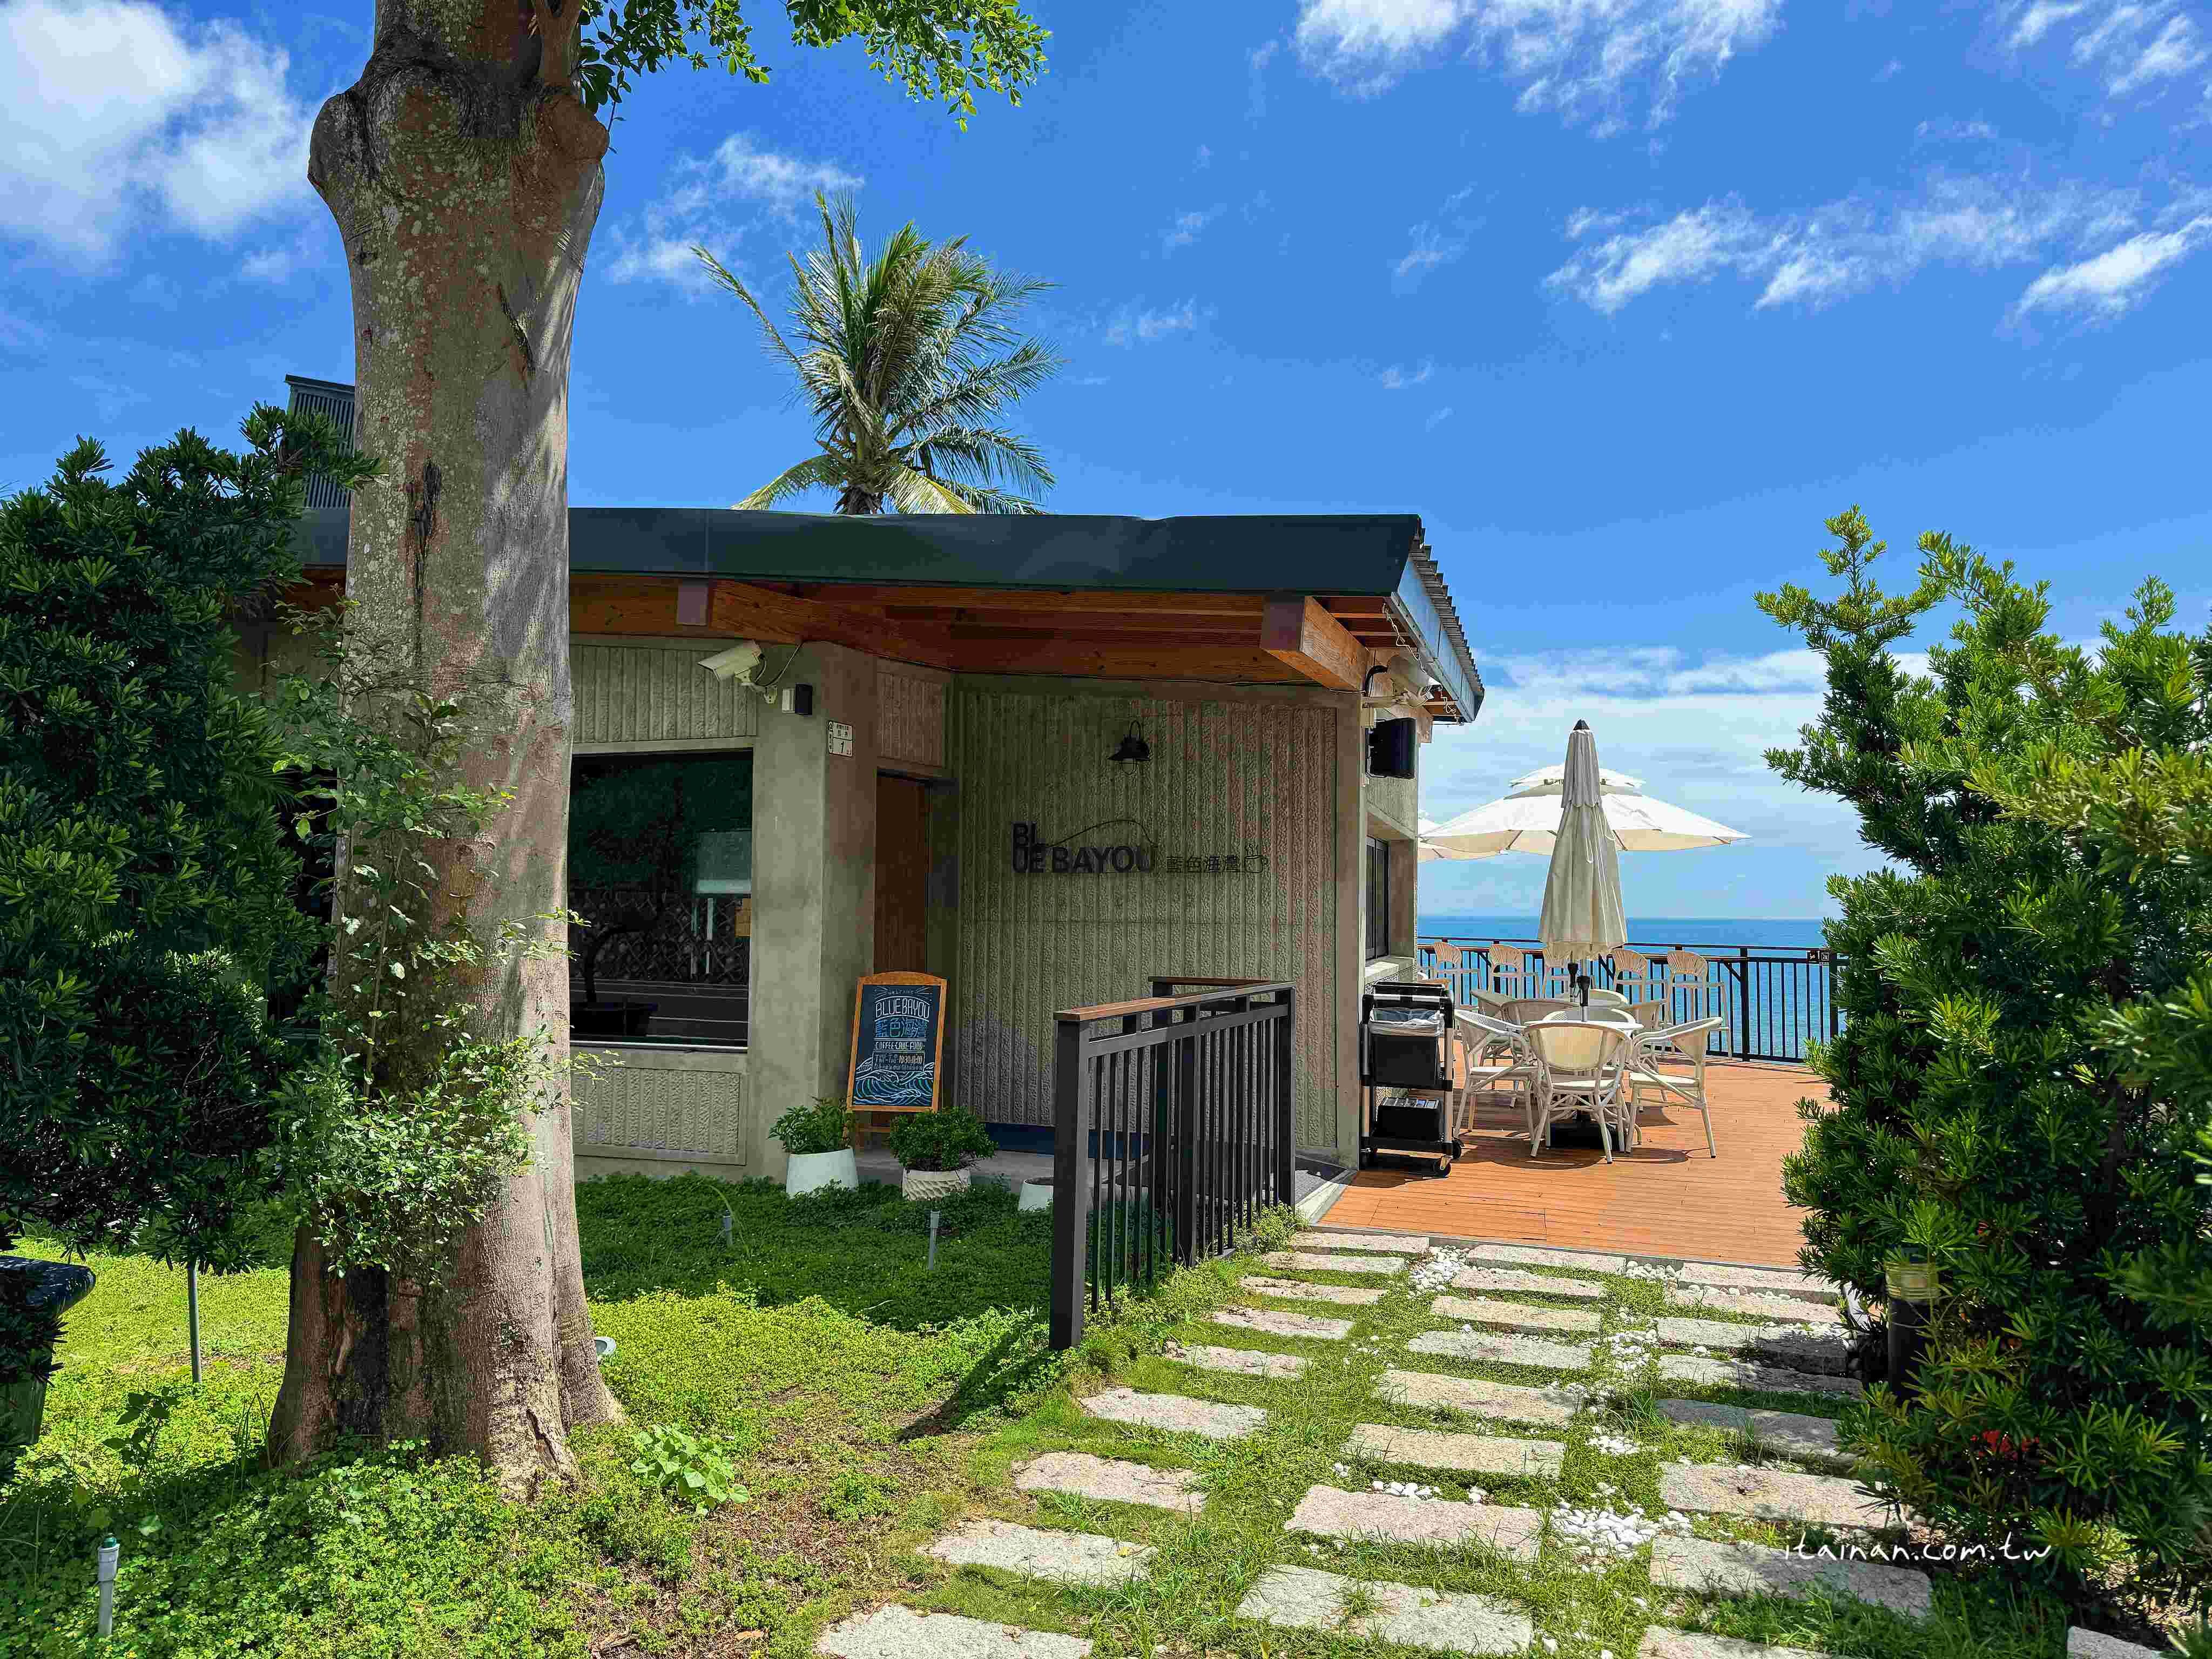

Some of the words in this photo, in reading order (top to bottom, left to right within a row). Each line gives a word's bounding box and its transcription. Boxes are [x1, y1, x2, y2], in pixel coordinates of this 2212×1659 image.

[1052, 846, 1155, 873] BAYOU
[875, 997, 901, 1018] BLUE
[902, 997, 930, 1019] BAYOU
